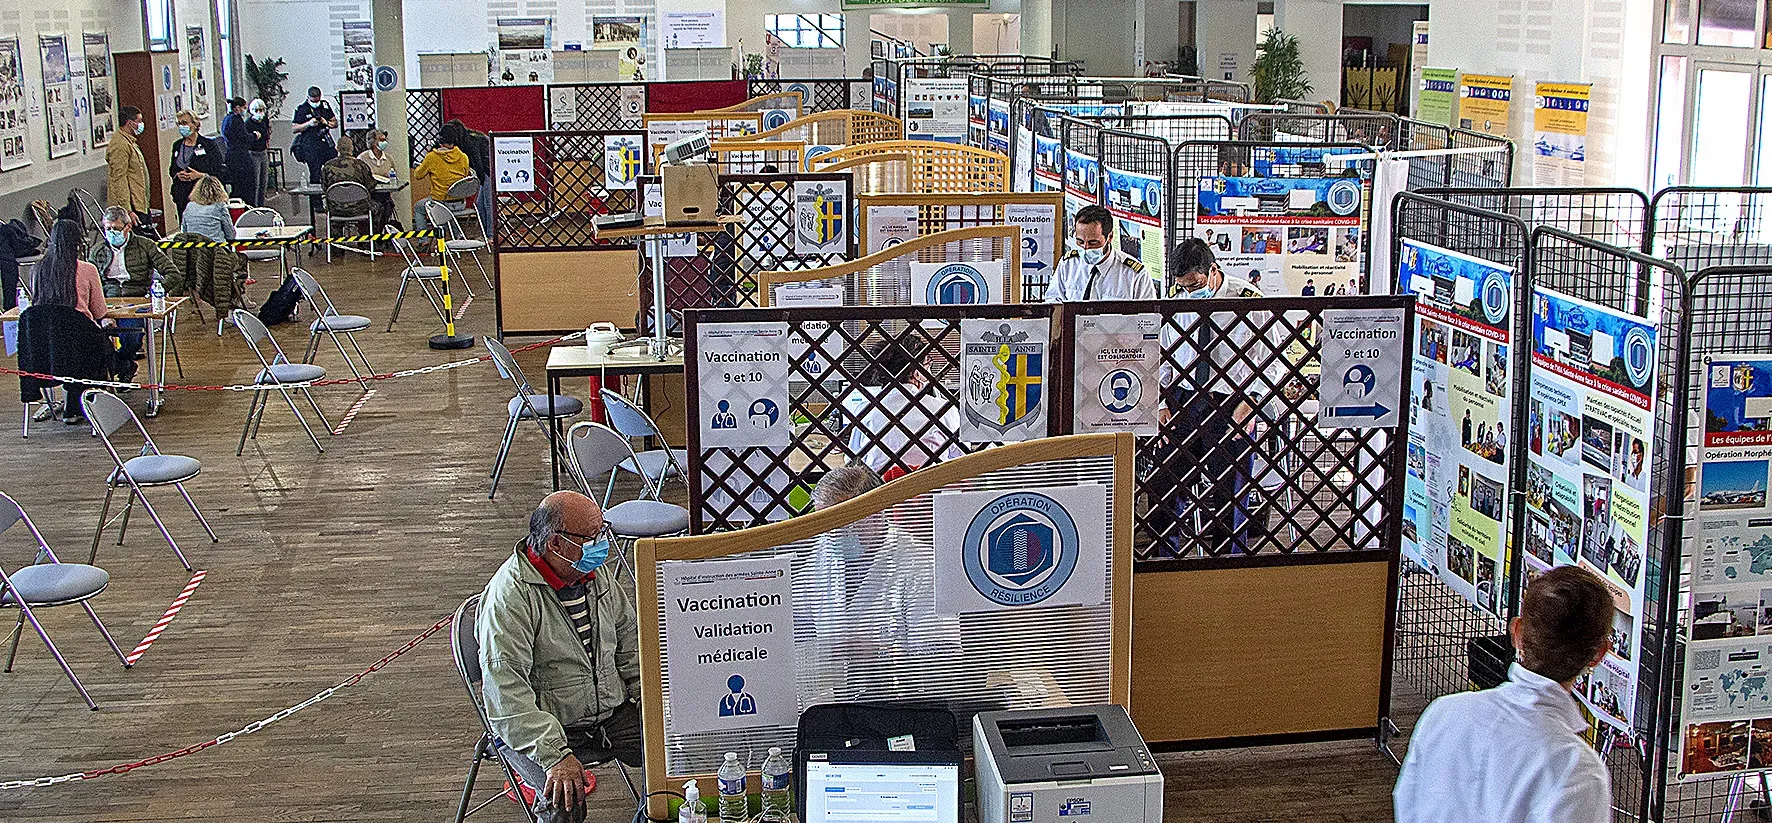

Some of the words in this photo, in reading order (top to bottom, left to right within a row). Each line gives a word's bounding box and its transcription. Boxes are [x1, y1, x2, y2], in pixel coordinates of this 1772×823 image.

[941, 267, 974, 275] OPÉRATION
[1329, 328, 1397, 339] Vaccination
[1486, 329, 1505, 340] COVID-19
[704, 350, 780, 362] Vaccination
[1344, 349, 1350, 358] 9
[1354, 350, 1364, 358] et
[1367, 349, 1379, 358] 10
[724, 372, 730, 382] 9
[734, 374, 745, 382] et
[749, 372, 762, 382] 10
[1630, 393, 1648, 407] COVID-19
[1726, 435, 1754, 445] équipes
[1705, 451, 1742, 460] Opération
[991, 497, 1051, 515] OPÉRATION
[990, 584, 1051, 602] RÉSILIENCE
[676, 592, 782, 612] Vaccination
[694, 622, 773, 639] Validation
[698, 647, 768, 664] médicale
